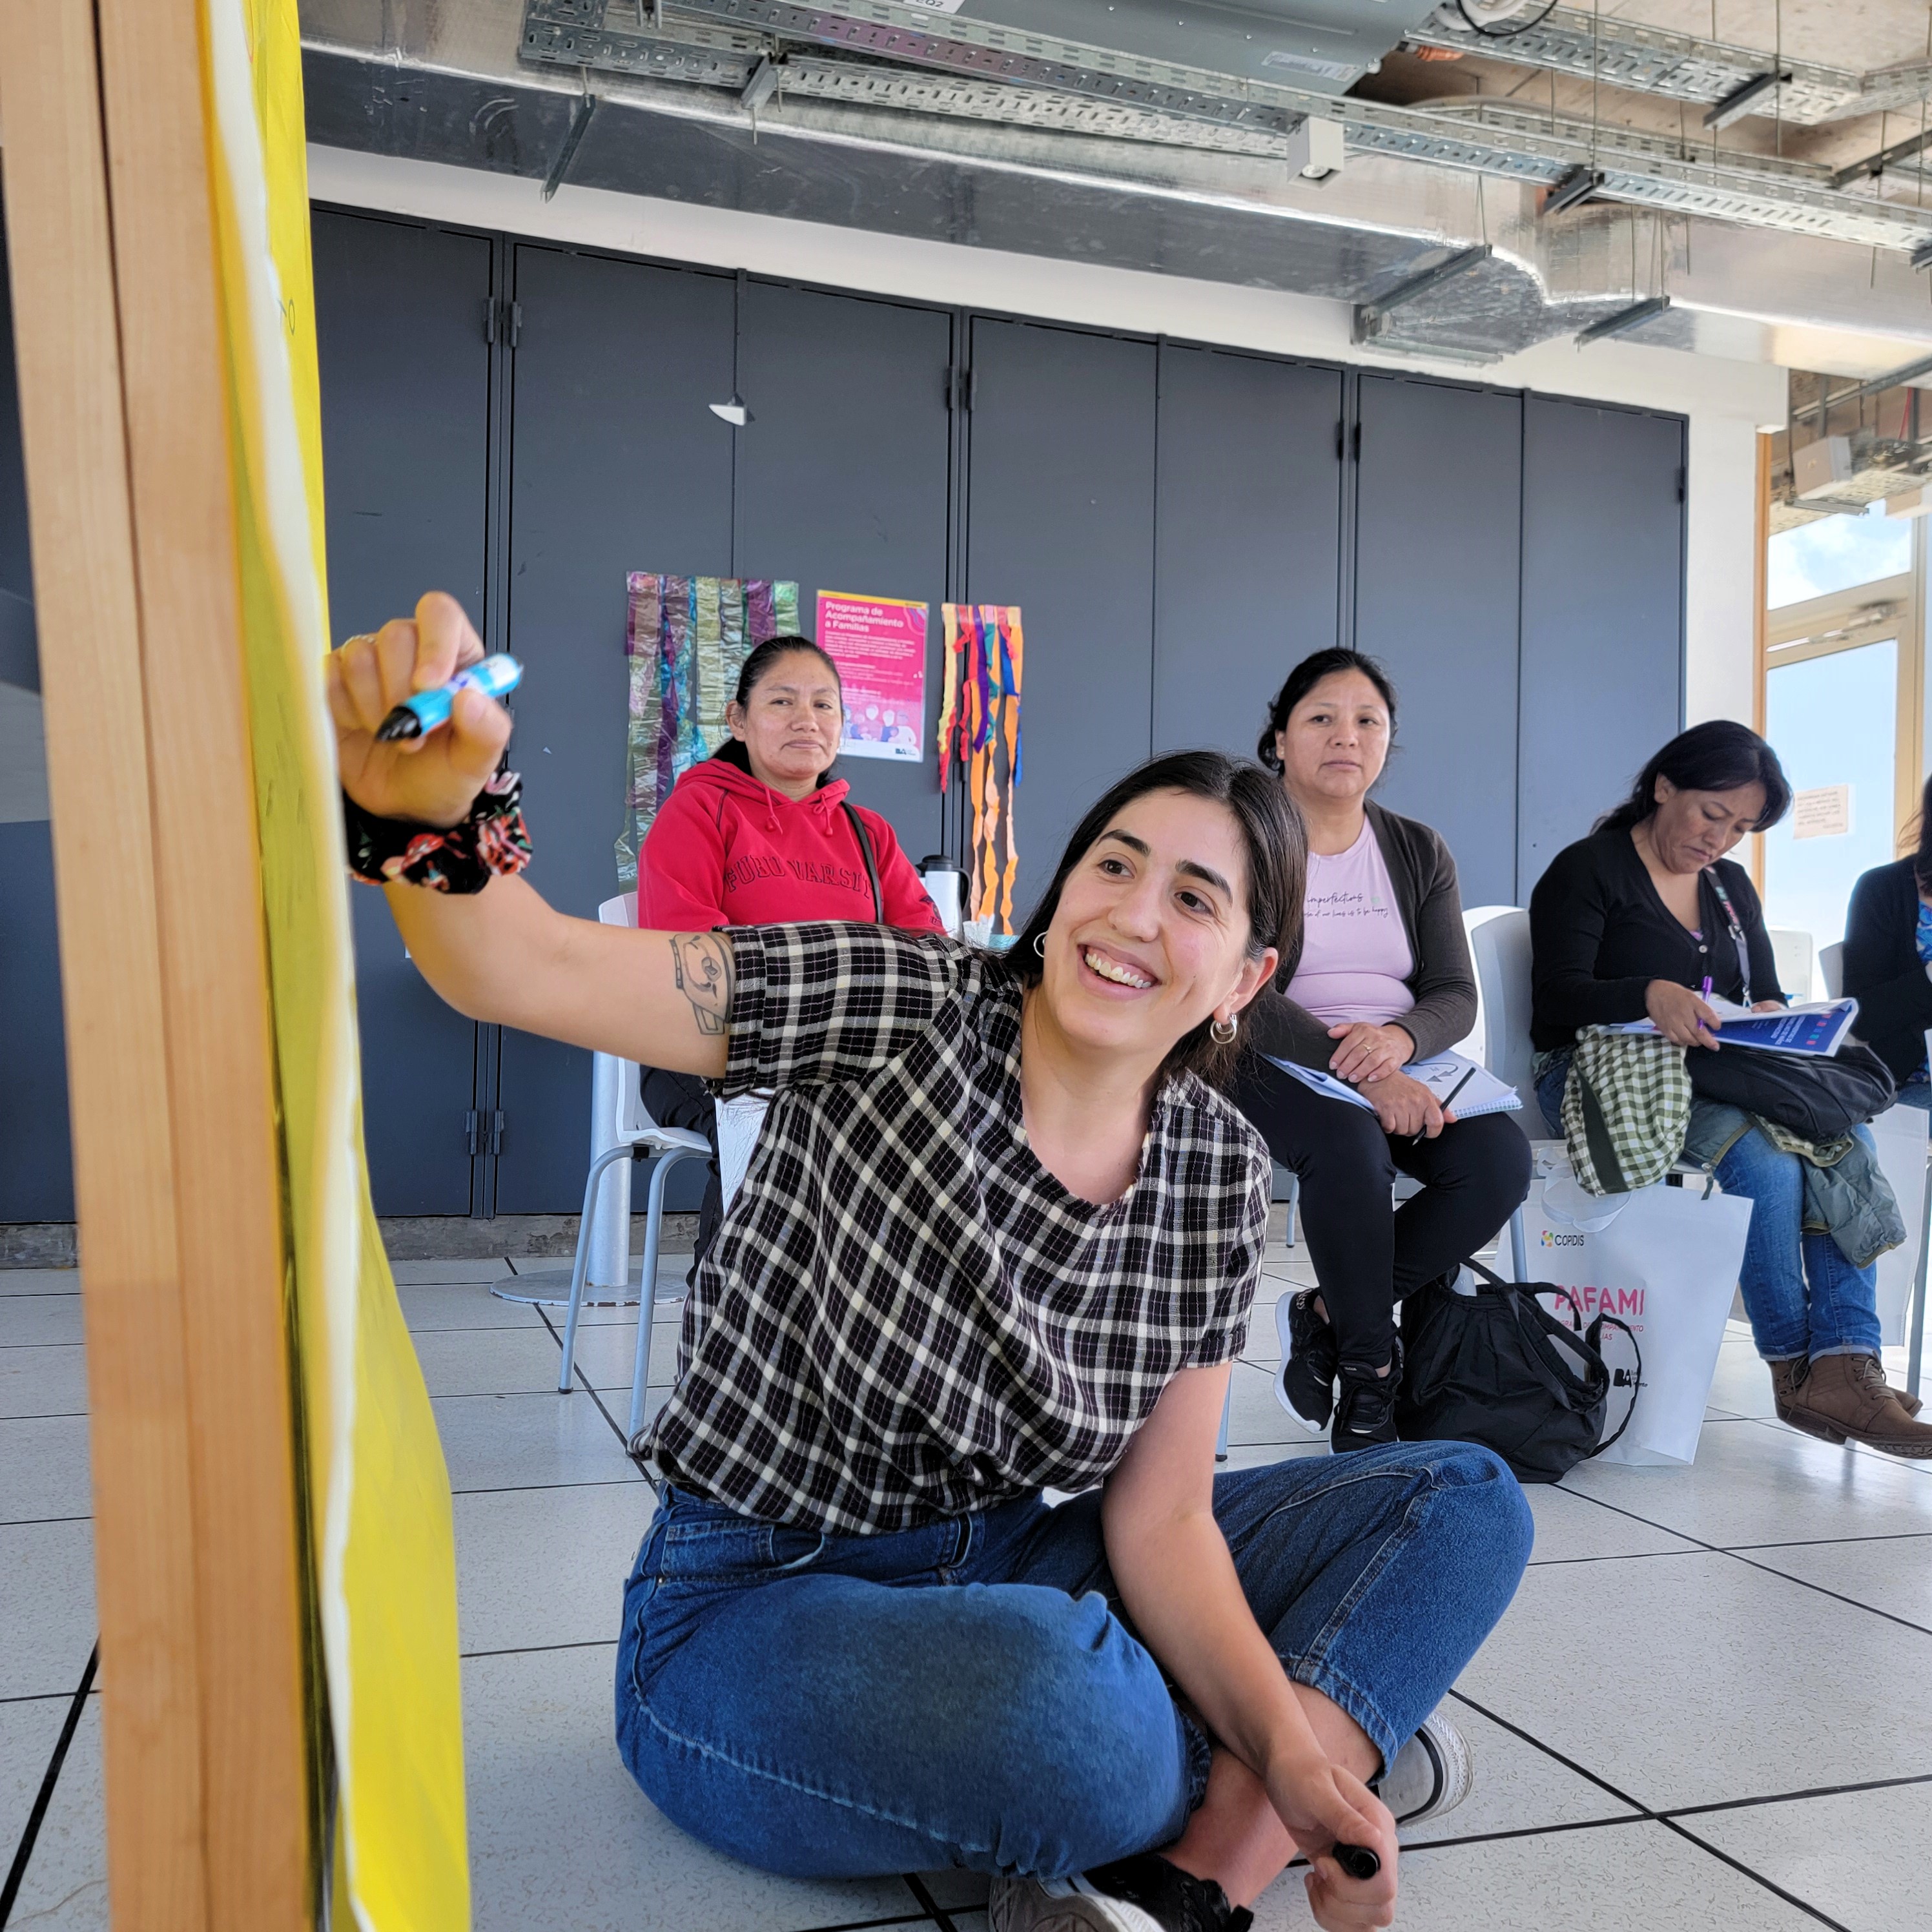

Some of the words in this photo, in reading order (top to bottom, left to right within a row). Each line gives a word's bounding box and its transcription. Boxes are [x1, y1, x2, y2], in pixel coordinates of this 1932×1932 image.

[825, 601, 870, 615] Programa
[870, 607, 883, 616] de
[825, 610, 904, 628] Acompañamiento
[832, 620, 869, 632] Familias
[1555, 1235, 1584, 1246] COPIDIS
[1555, 1285, 1645, 1316] PAFAMI
